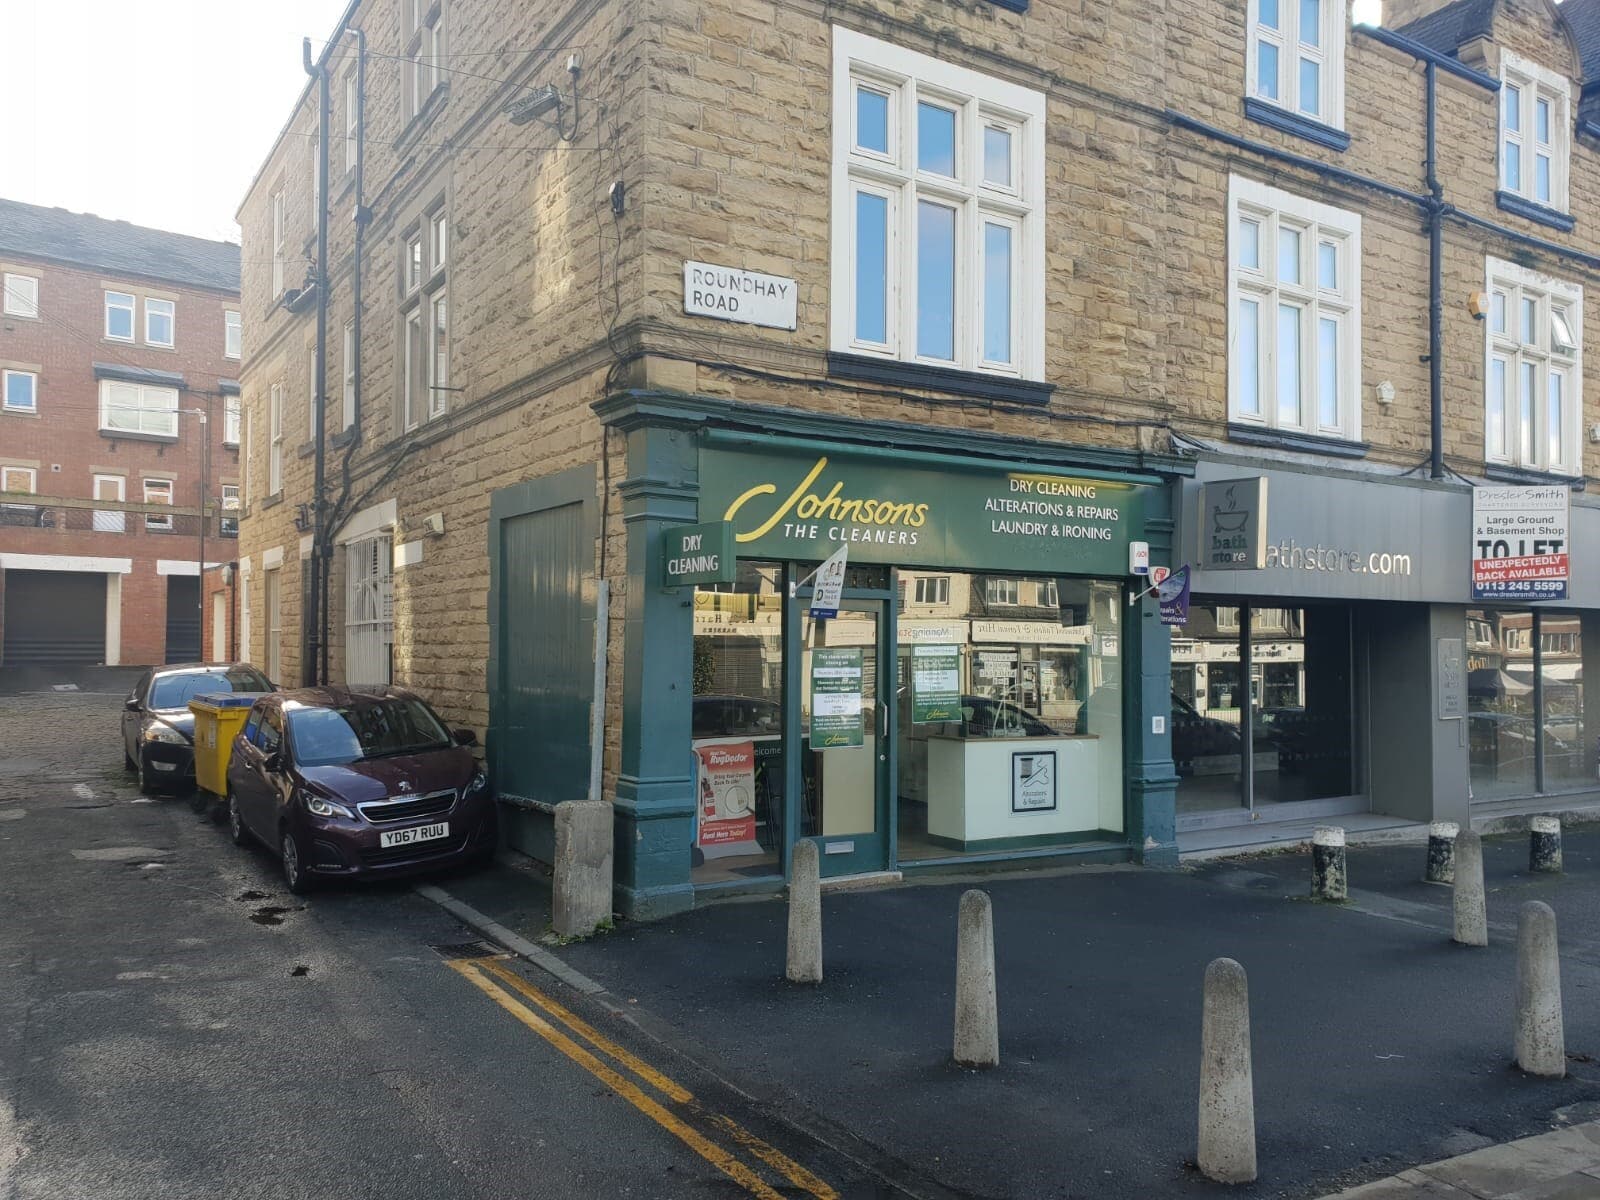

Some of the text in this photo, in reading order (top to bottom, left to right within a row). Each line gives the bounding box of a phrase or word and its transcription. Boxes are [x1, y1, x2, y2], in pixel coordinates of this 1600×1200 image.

[693, 269, 787, 299] ROUNDHAY
[693, 290, 739, 312] ROAD
[1010, 480, 1096, 499] DRY CLEANING
[723, 457, 929, 543] Johnsons
[985, 498, 1119, 521] ALTERATIONS & REPAIRS
[991, 520, 1112, 540] LAUNDRY & IRONING
[1487, 516, 1554, 526] Large Ground
[784, 524, 918, 545] THE CLEANERS
[1477, 527, 1564, 536] & Basement Shop
[682, 535, 702, 552] DRY
[1212, 535, 1248, 550] bath
[1477, 540, 1563, 559] TO LET
[668, 554, 719, 576] CLEANING
[1212, 550, 1247, 564] store
[1266, 537, 1411, 576] athstore.com
[1479, 556, 1561, 570] UNEXPECTEDLY
[1476, 566, 1566, 580] BACK AVAILABLE
[1476, 581, 1564, 590] 0113 245 5599
[755, 747, 781, 755] elcome
[386, 824, 444, 844] YD67 RUU
